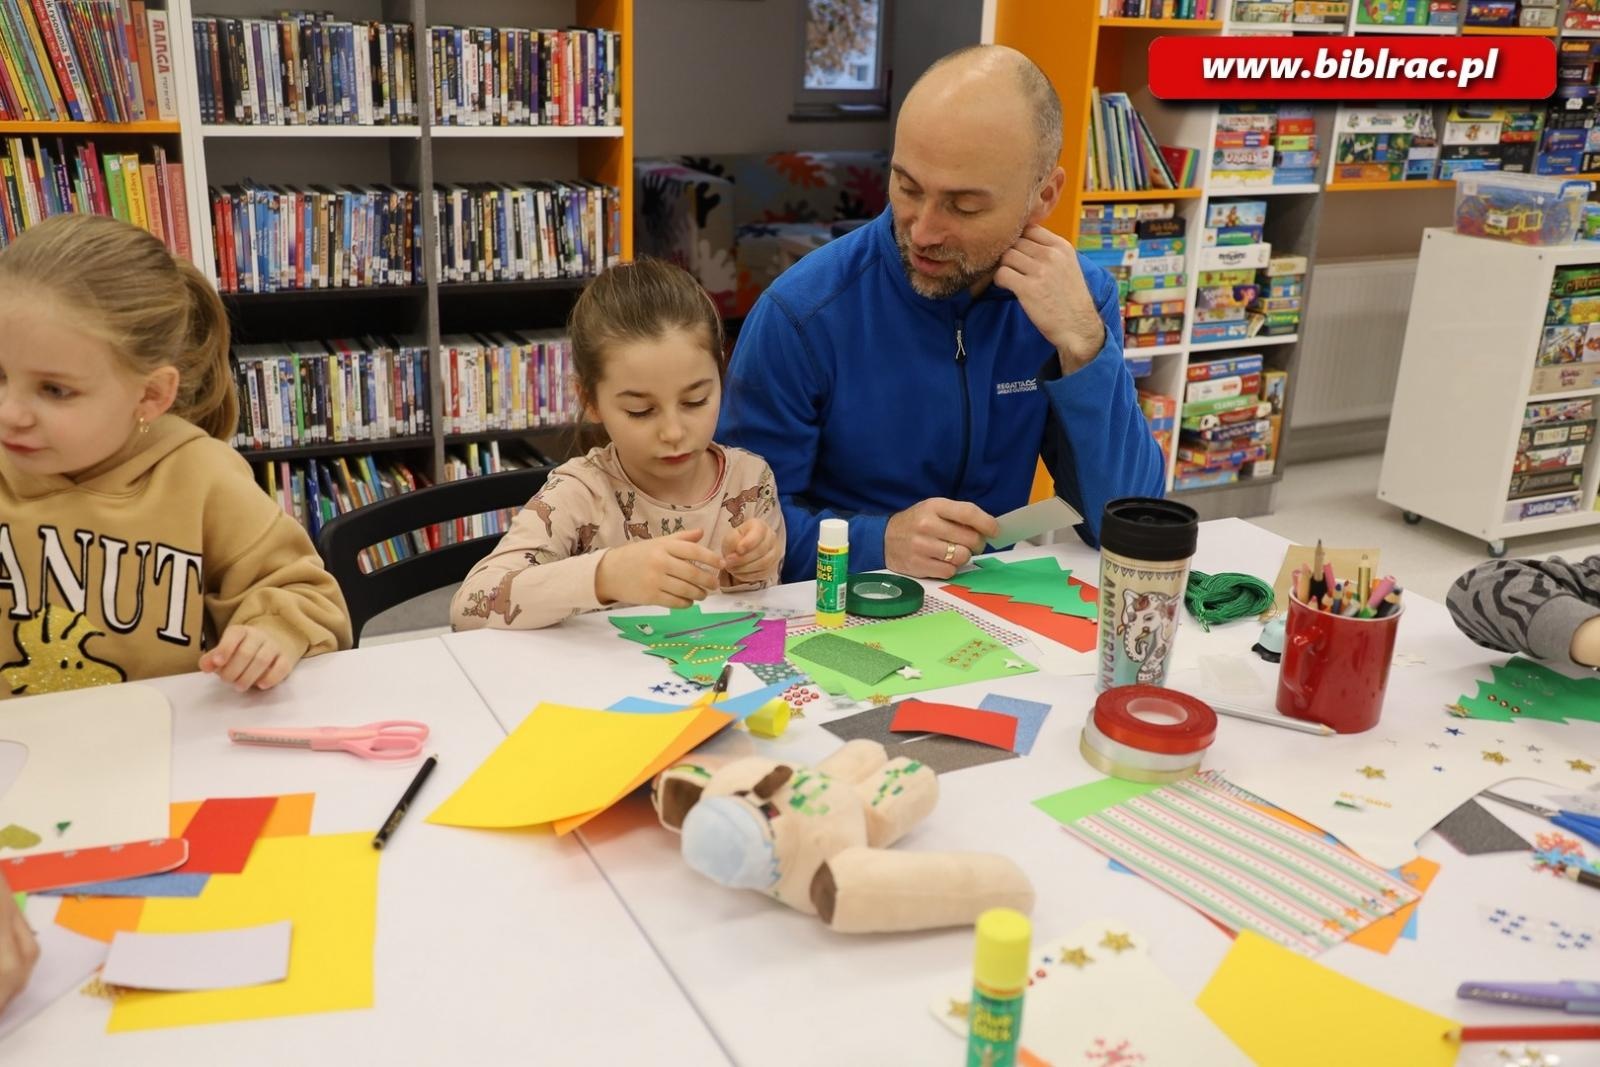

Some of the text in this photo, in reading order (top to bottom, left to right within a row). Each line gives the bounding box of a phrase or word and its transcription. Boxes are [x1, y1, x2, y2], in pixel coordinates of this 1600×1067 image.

[48, 10, 68, 53] rysowania
[153, 19, 170, 73] MANGA
[997, 381, 1026, 389] REGATTA
[1101, 576, 1116, 689] AMSTERDAM
